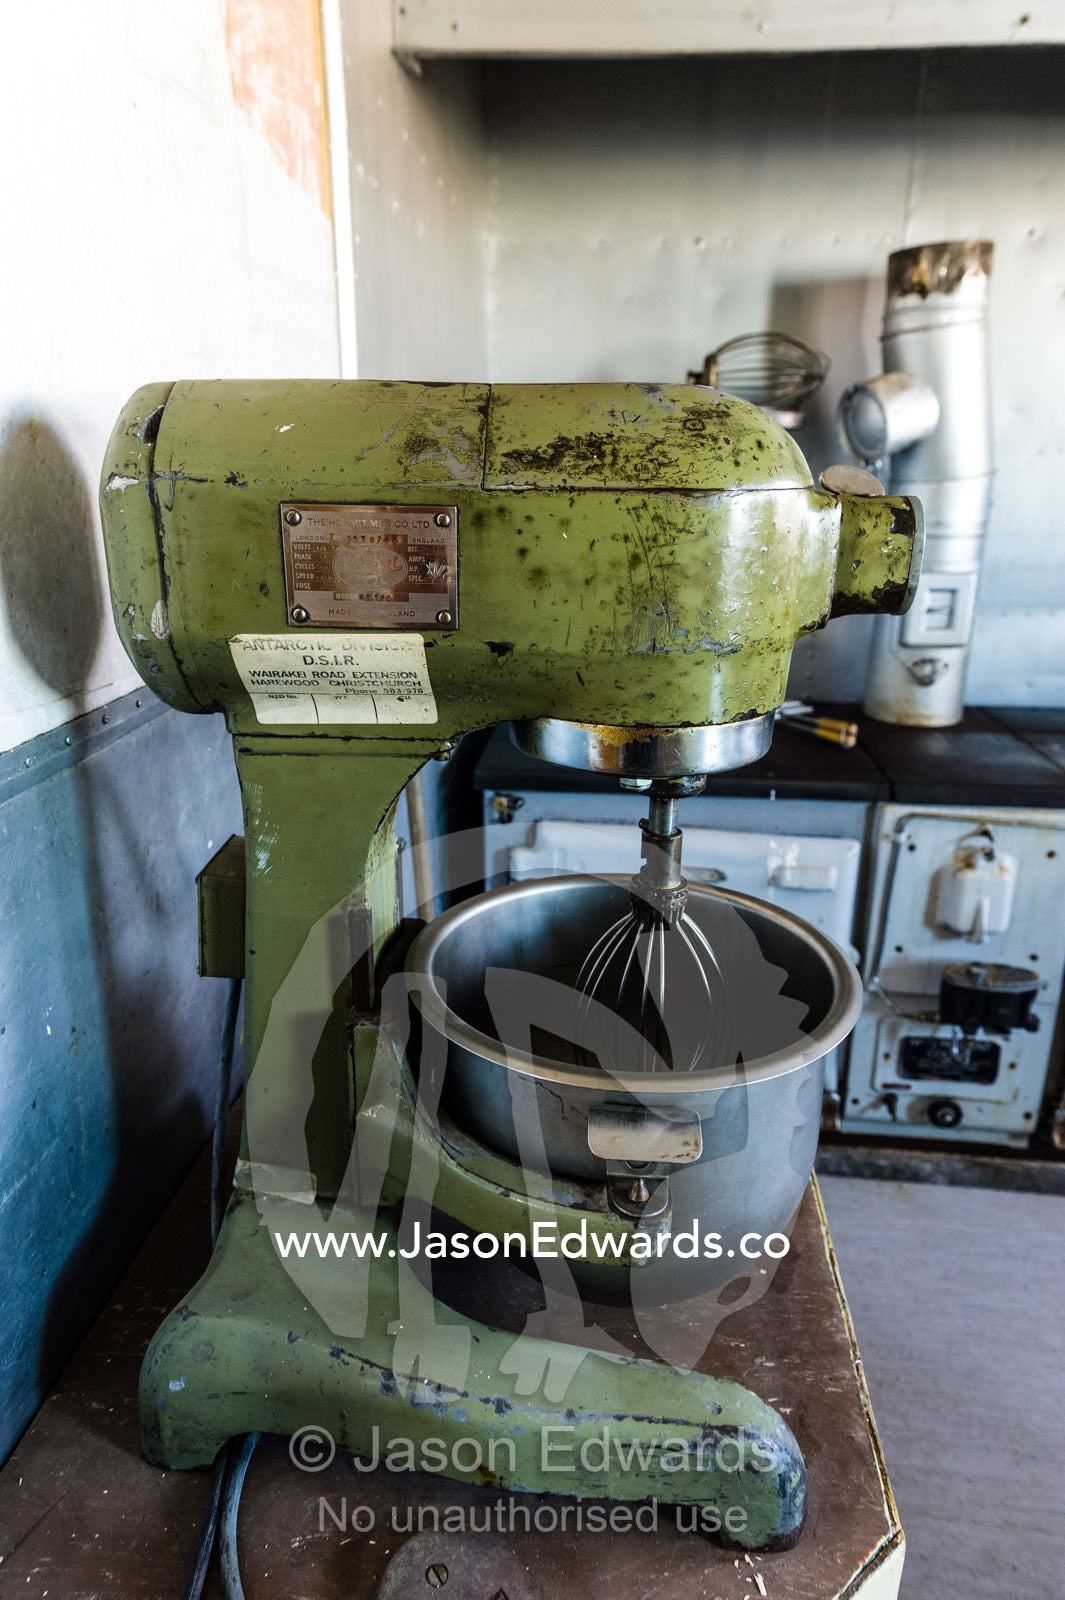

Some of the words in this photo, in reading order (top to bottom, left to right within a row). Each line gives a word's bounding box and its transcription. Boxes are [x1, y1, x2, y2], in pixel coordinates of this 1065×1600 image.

[307, 518, 326, 526] THE
[328, 518, 367, 527] HORT
[412, 520, 432, 529] LTD.
[293, 552, 312, 560] PHASE
[294, 562, 316, 570] CYCLES
[295, 572, 315, 580] SPEED
[295, 582, 312, 590] FUSE
[328, 608, 352, 616] MADE
[375, 609, 416, 617] LAND
[243, 639, 332, 651] ANTARCTIC
[303, 655, 360, 666] D.S.I.R.
[248, 670, 307, 679] WAIRAKEI
[312, 670, 346, 679] ROAD
[352, 671, 418, 679] EXTENSION
[250, 679, 320, 687] HAREWOOD
[329, 679, 422, 688] CHRISTCHURCH
